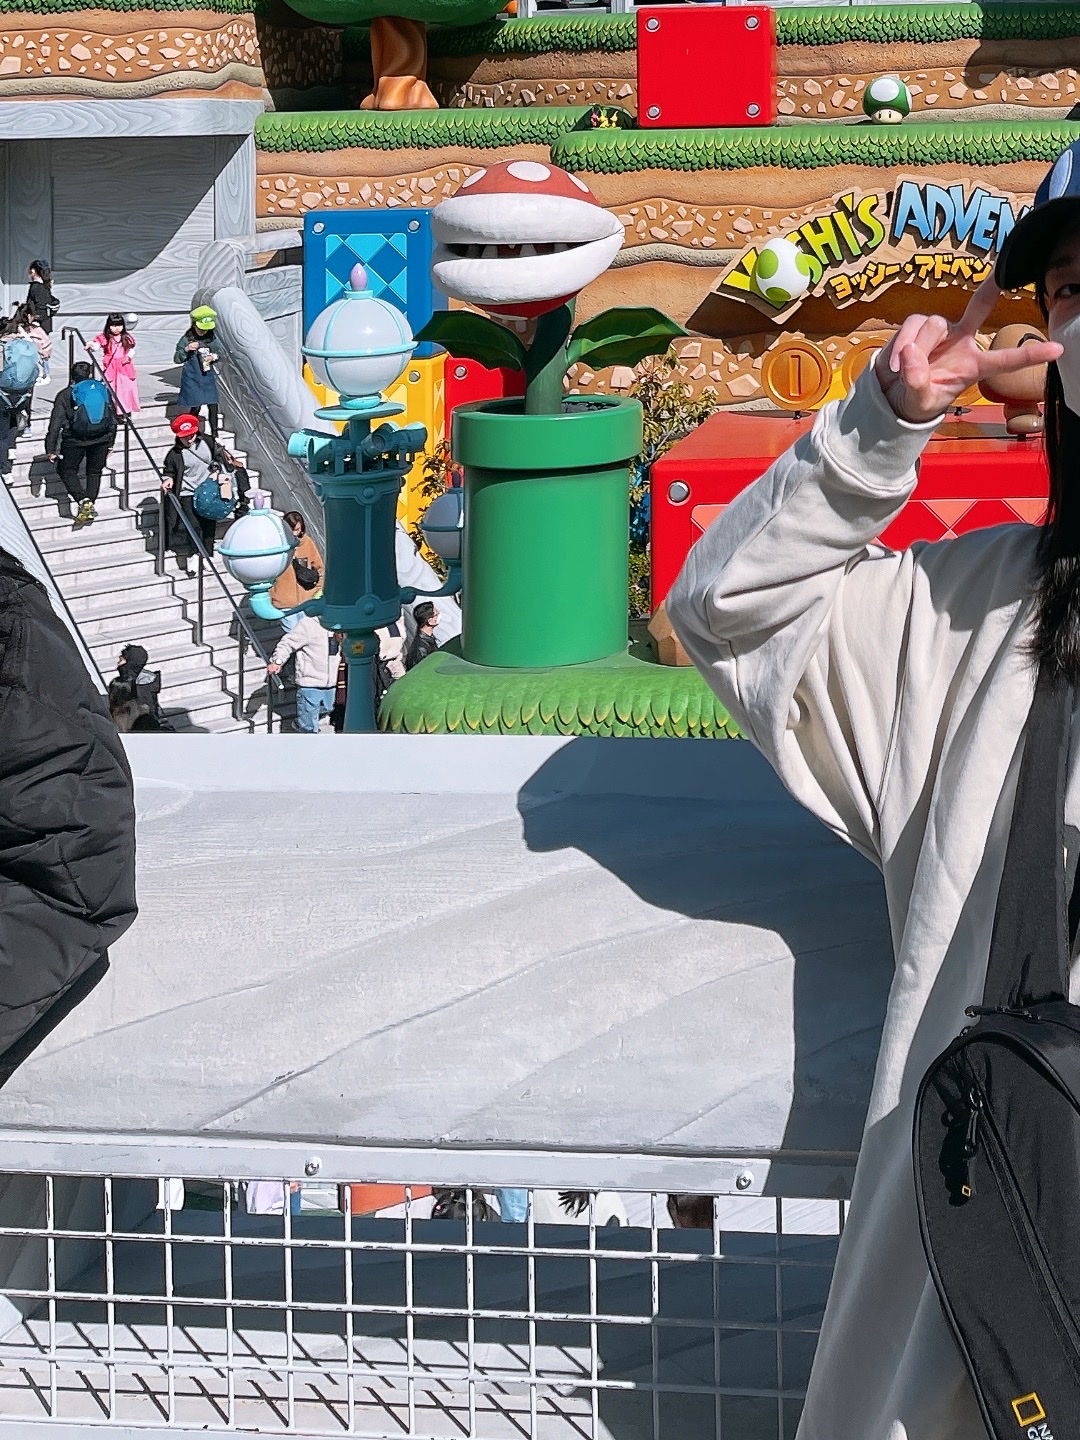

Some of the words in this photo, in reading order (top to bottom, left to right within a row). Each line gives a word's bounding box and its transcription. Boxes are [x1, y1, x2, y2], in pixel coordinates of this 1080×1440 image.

[893, 181, 1035, 253] ADVEN
[828, 252, 994, 301] ヨッシー・アドベン
[1027, 1426, 1041, 1440] G
